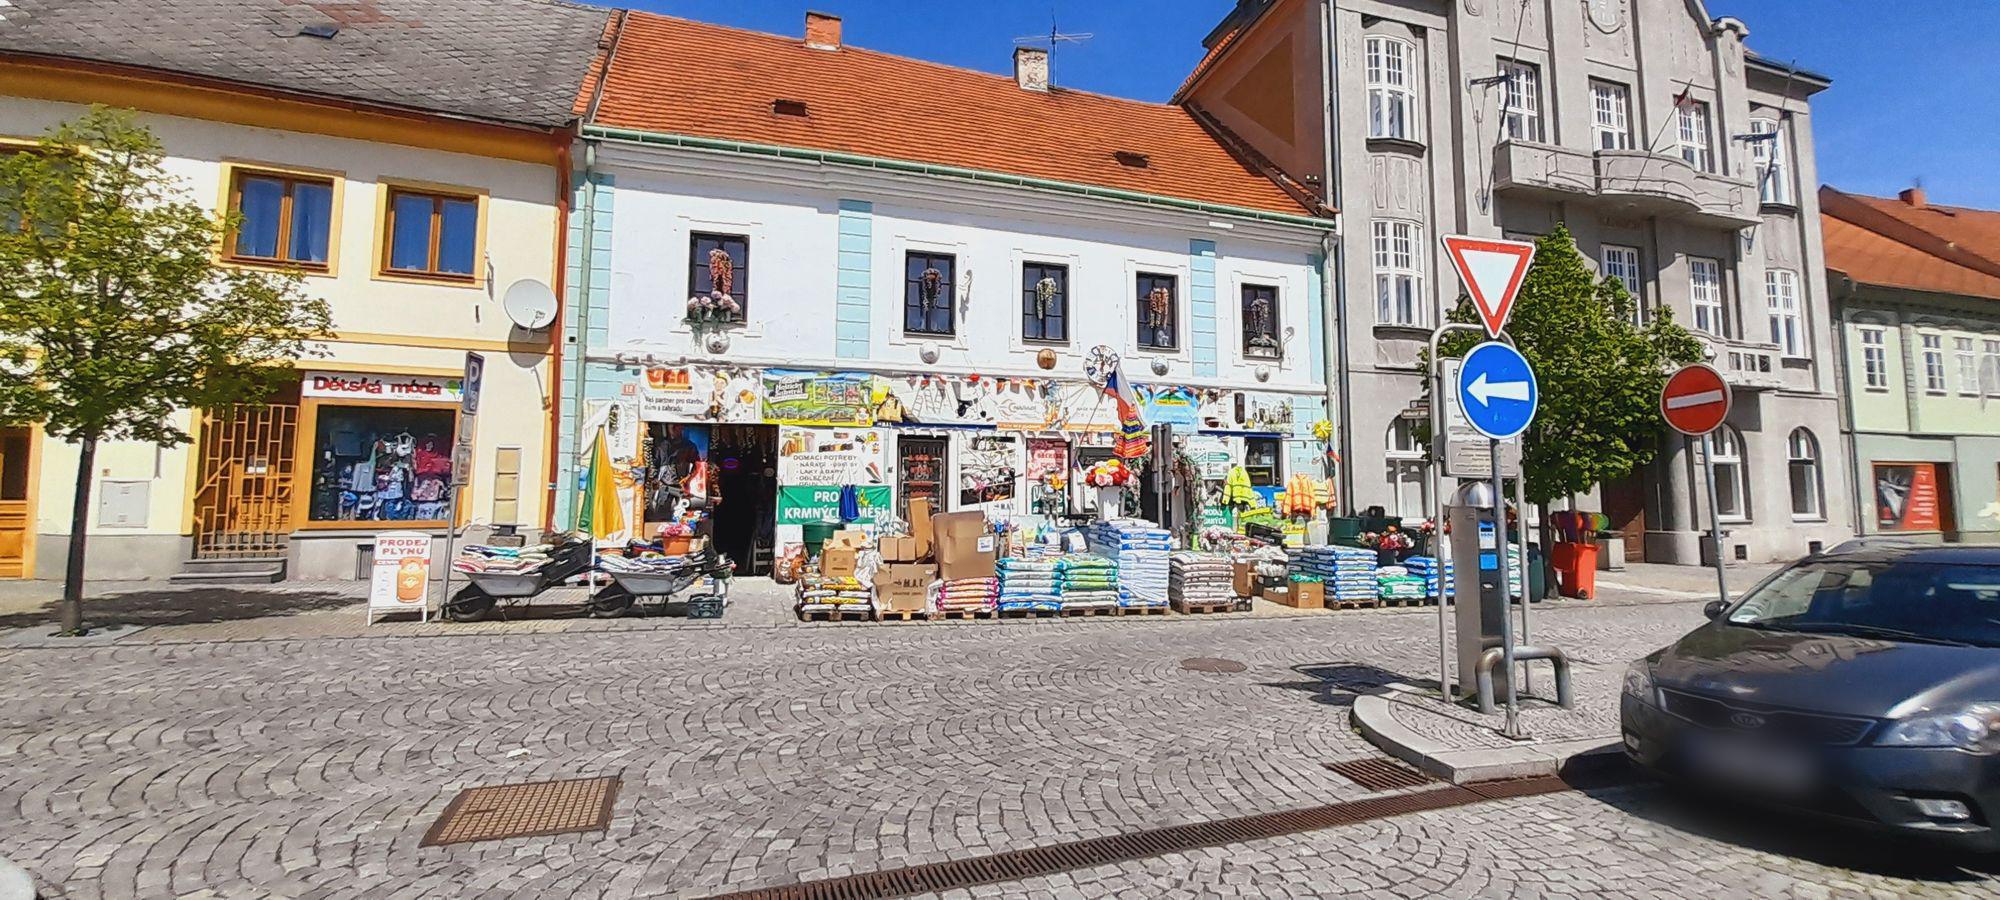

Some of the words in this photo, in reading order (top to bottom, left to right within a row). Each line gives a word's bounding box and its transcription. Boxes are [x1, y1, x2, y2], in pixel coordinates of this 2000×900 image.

[313, 375, 383, 394] Dětská
[390, 379, 441, 395] móda
[814, 490, 858, 502] PRO
[382, 547, 424, 555] PLYNU
